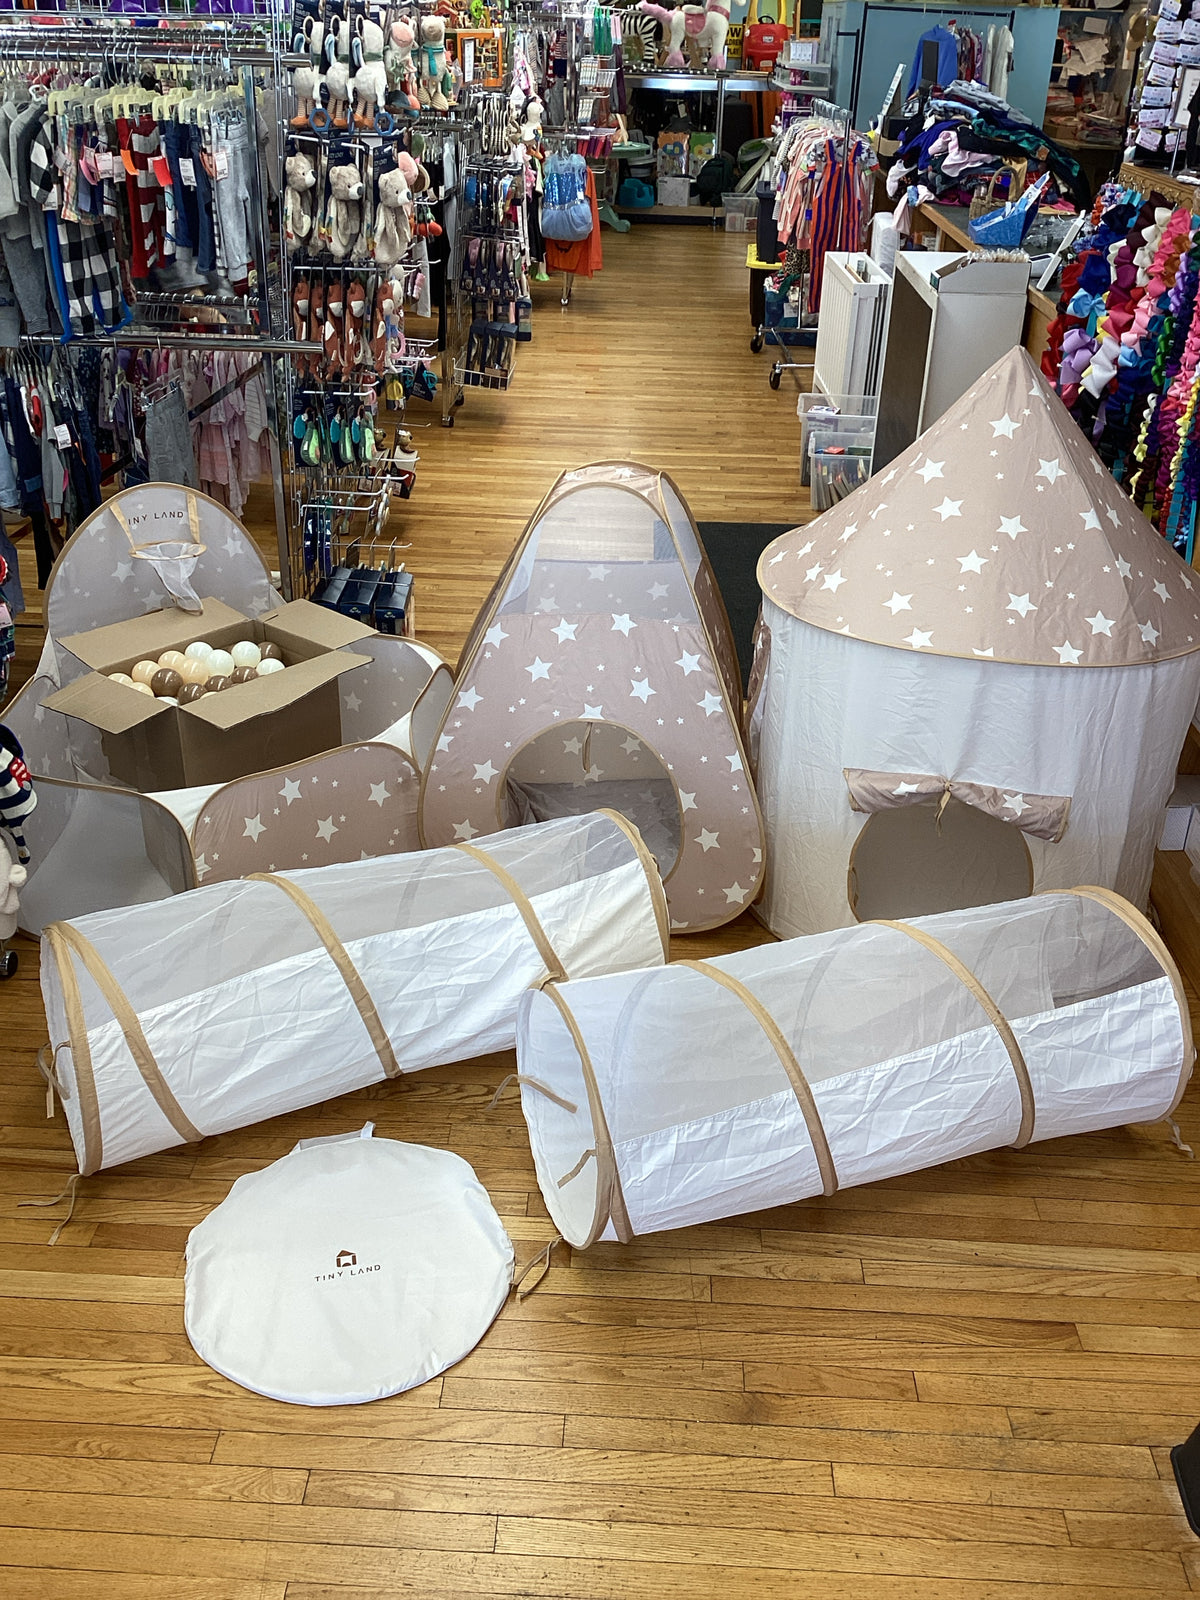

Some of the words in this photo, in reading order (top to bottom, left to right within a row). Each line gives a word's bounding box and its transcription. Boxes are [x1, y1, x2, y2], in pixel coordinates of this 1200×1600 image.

[128, 514, 148, 525] INY
[154, 511, 184, 520] LAND
[314, 1271, 344, 1282] TINY
[350, 1264, 381, 1276] LAND
